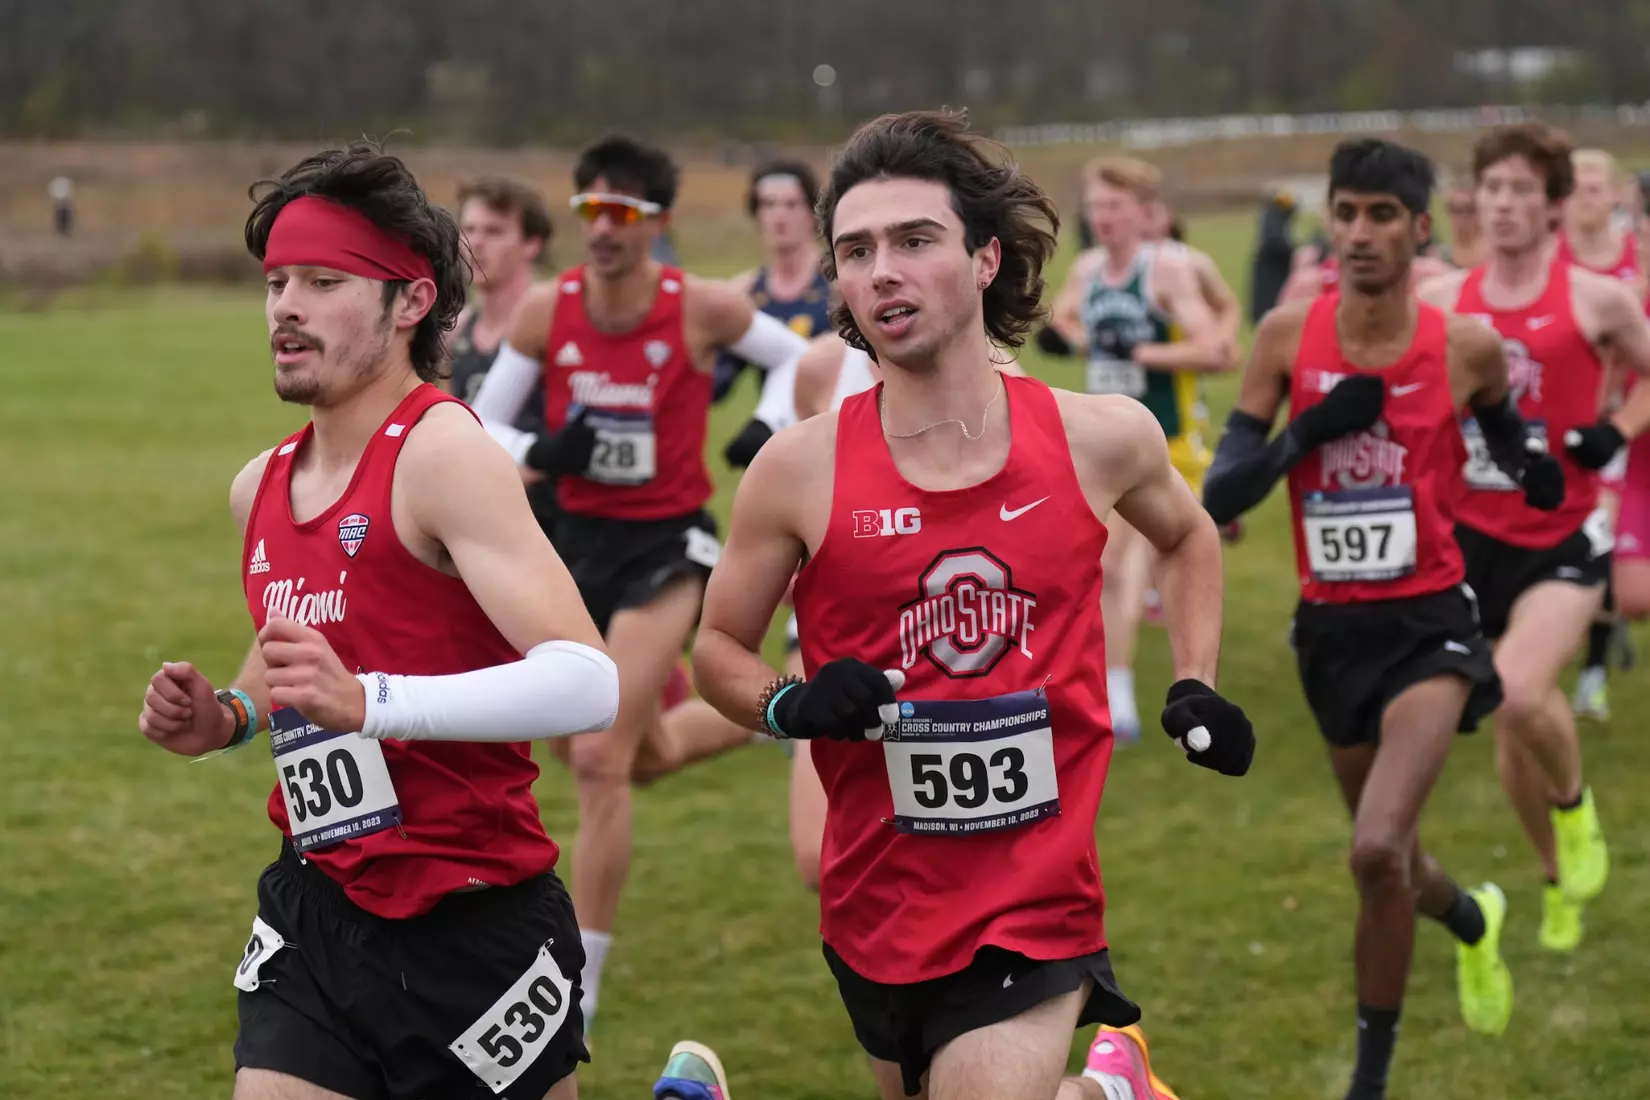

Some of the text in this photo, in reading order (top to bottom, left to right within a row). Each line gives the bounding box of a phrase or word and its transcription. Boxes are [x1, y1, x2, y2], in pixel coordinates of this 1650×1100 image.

[569, 371, 658, 407] Miami
[339, 526, 367, 540] MAC
[1320, 524, 1392, 563] 597
[249, 560, 270, 575] adidas
[262, 570, 347, 627] Miami
[901, 709, 1047, 733] CROSS COUNTRY CHAMPIONSHIPS
[283, 748, 364, 823] 530
[910, 747, 1029, 809] 593
[320, 824, 352, 841] NOVEMBER
[361, 815, 381, 829] 2023
[913, 821, 948, 832] MADISON,
[949, 823, 959, 832] WI
[964, 817, 1007, 832] NOVEMBER
[1020, 808, 1040, 822] 2023
[240, 932, 265, 976] 0
[477, 976, 562, 1067] 530
